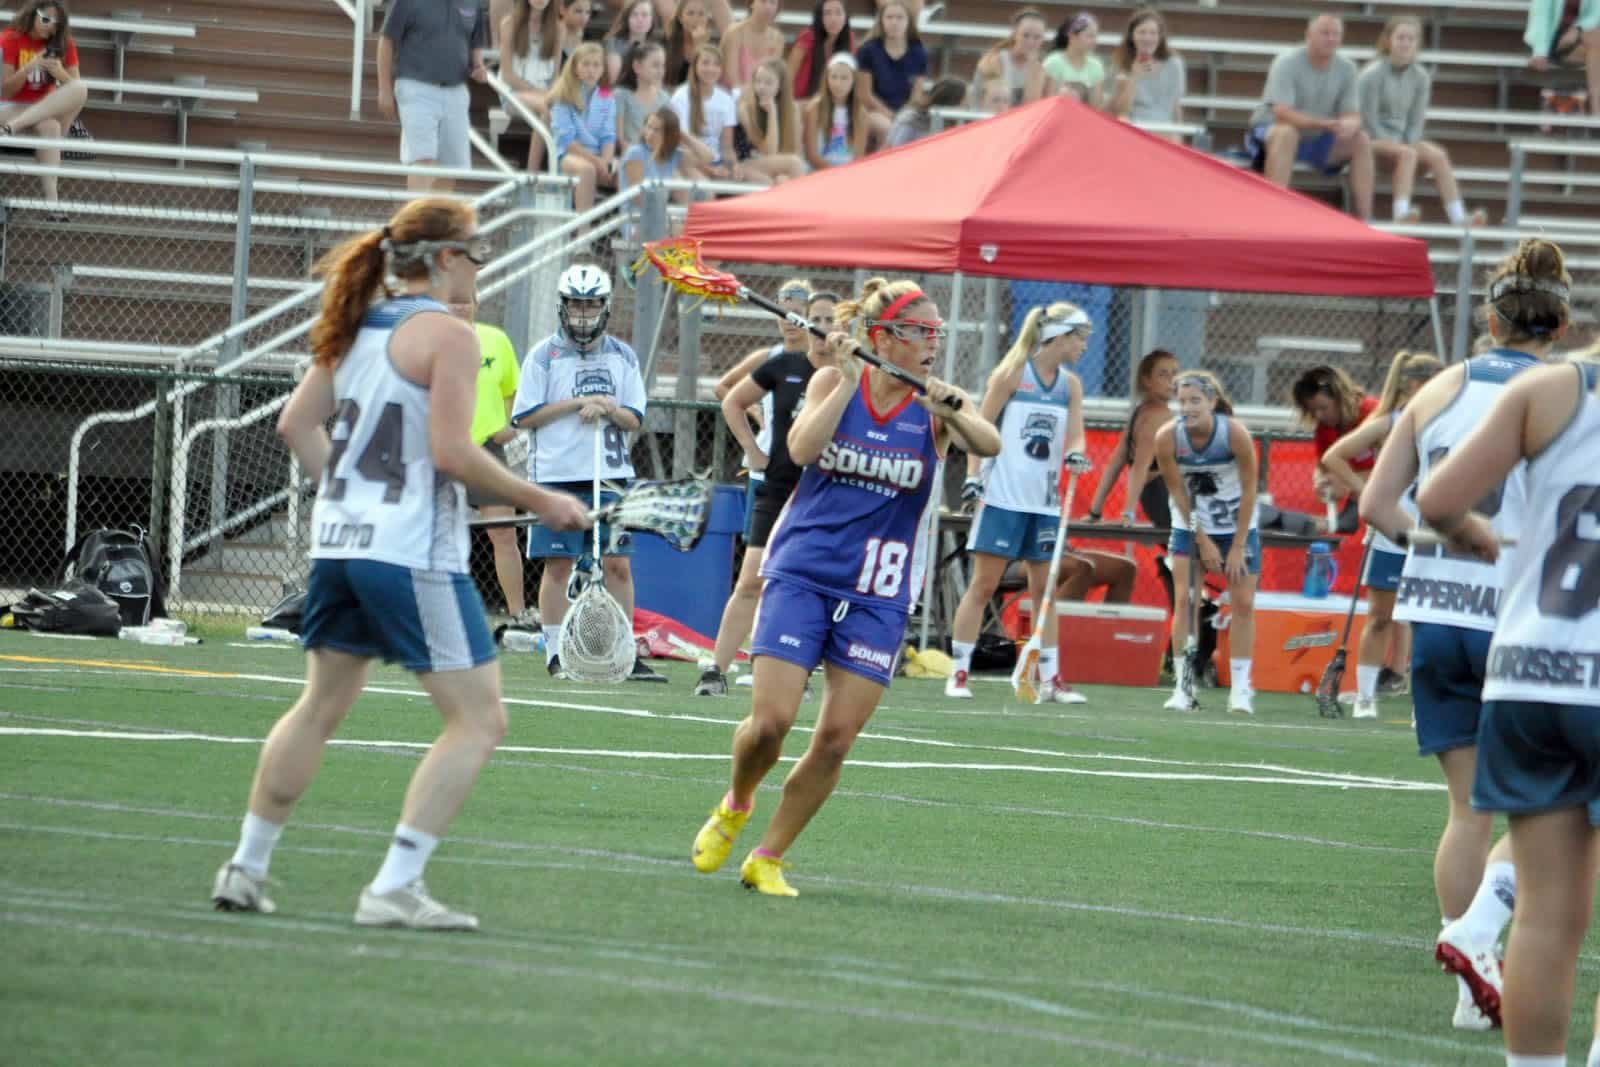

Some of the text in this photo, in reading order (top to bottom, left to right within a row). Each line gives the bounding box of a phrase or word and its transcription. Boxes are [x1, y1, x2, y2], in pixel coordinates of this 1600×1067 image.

[327, 398, 407, 505] 24
[866, 430, 888, 442] STX
[818, 442, 923, 489] SOUND
[856, 538, 909, 598] 18
[847, 643, 893, 669] SOUND
